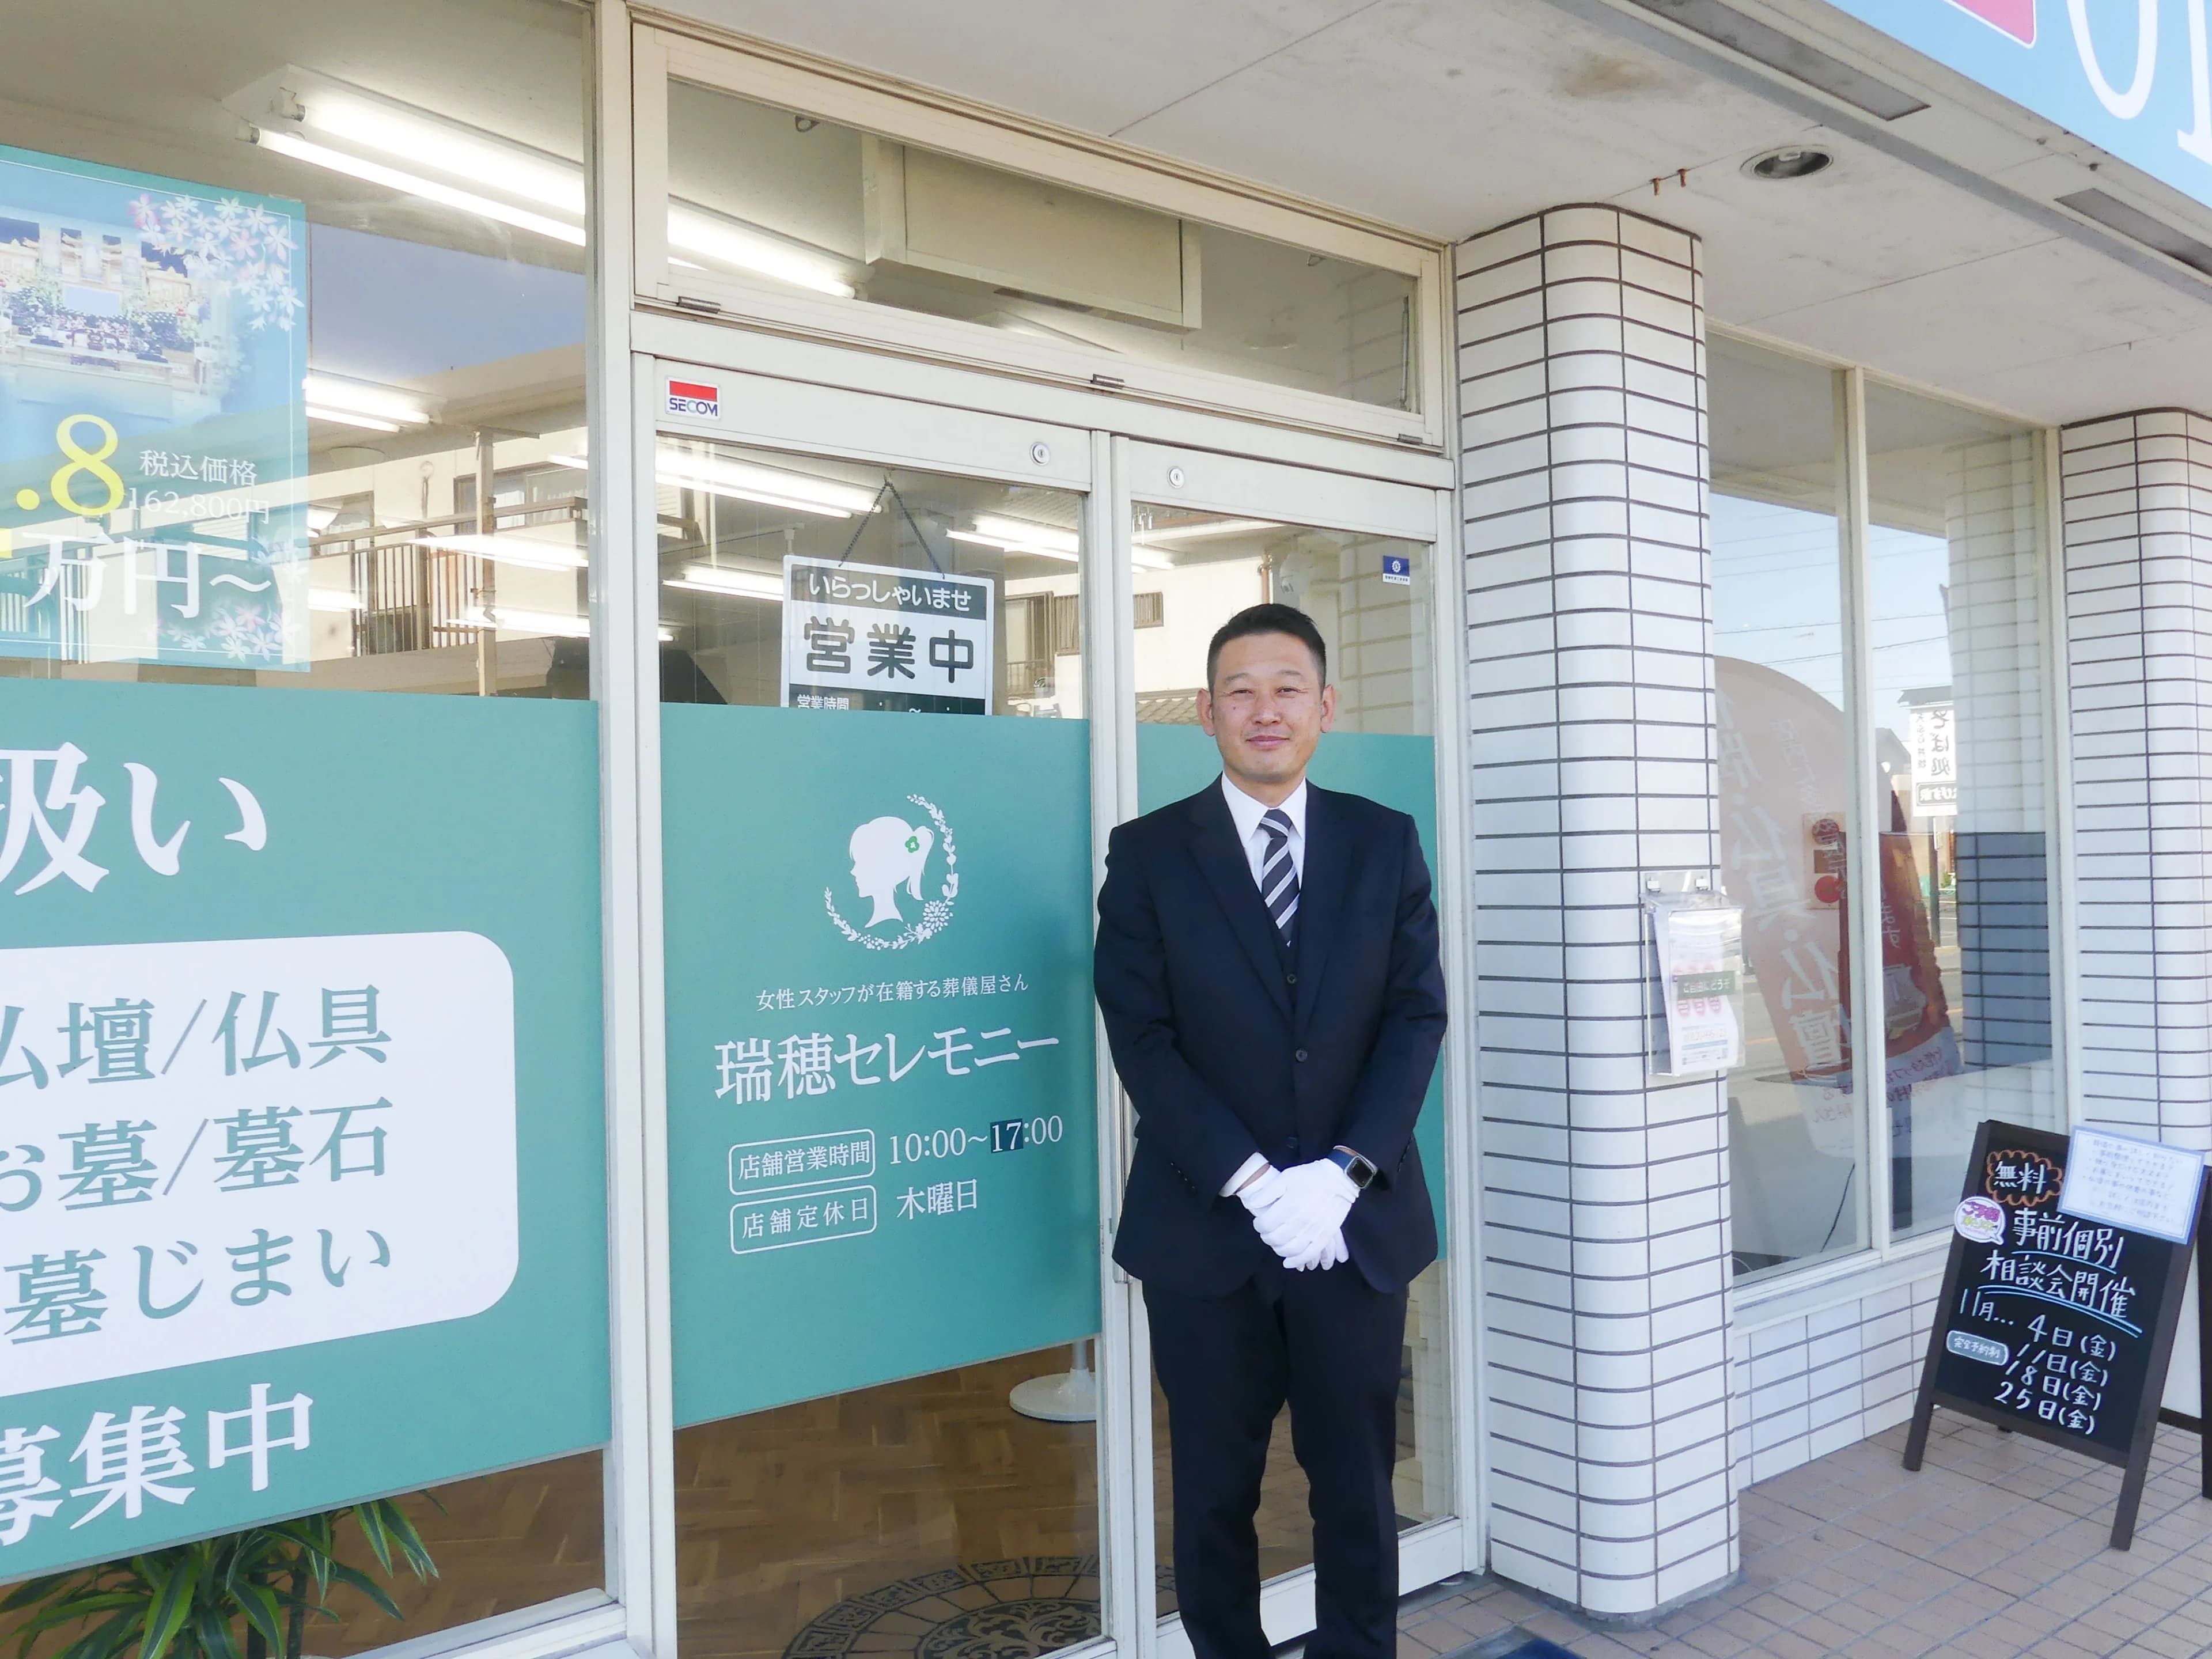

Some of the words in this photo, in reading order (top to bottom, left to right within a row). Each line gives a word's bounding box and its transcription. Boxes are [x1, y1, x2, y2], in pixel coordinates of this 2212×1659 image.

[669, 397, 718, 416] SECOM
[139, 449, 257, 487] 税込価格
[128, 487, 270, 524] 162,800円
[809, 573, 972, 612] いらっしゃいませ
[804, 615, 975, 683] 営業中
[797, 694, 850, 710] 営業時間
[756, 973, 1029, 1012] 女性スタッフが在籍する葬儀屋さん
[714, 1027, 1059, 1105] 瑞穂セレモニー
[738, 1140, 870, 1180] 店舗営業時間
[1993, 1160, 2047, 1195] 無料
[742, 1196, 869, 1240] 店舗定休日
[896, 1178, 978, 1221] 木曜日
[2012, 1207, 2124, 1270] 事前個別
[0, 1229, 391, 1345] 墓じまい
[1980, 1249, 2137, 1319] 相談会開催
[1953, 1336, 2001, 1359] 完全予約制
